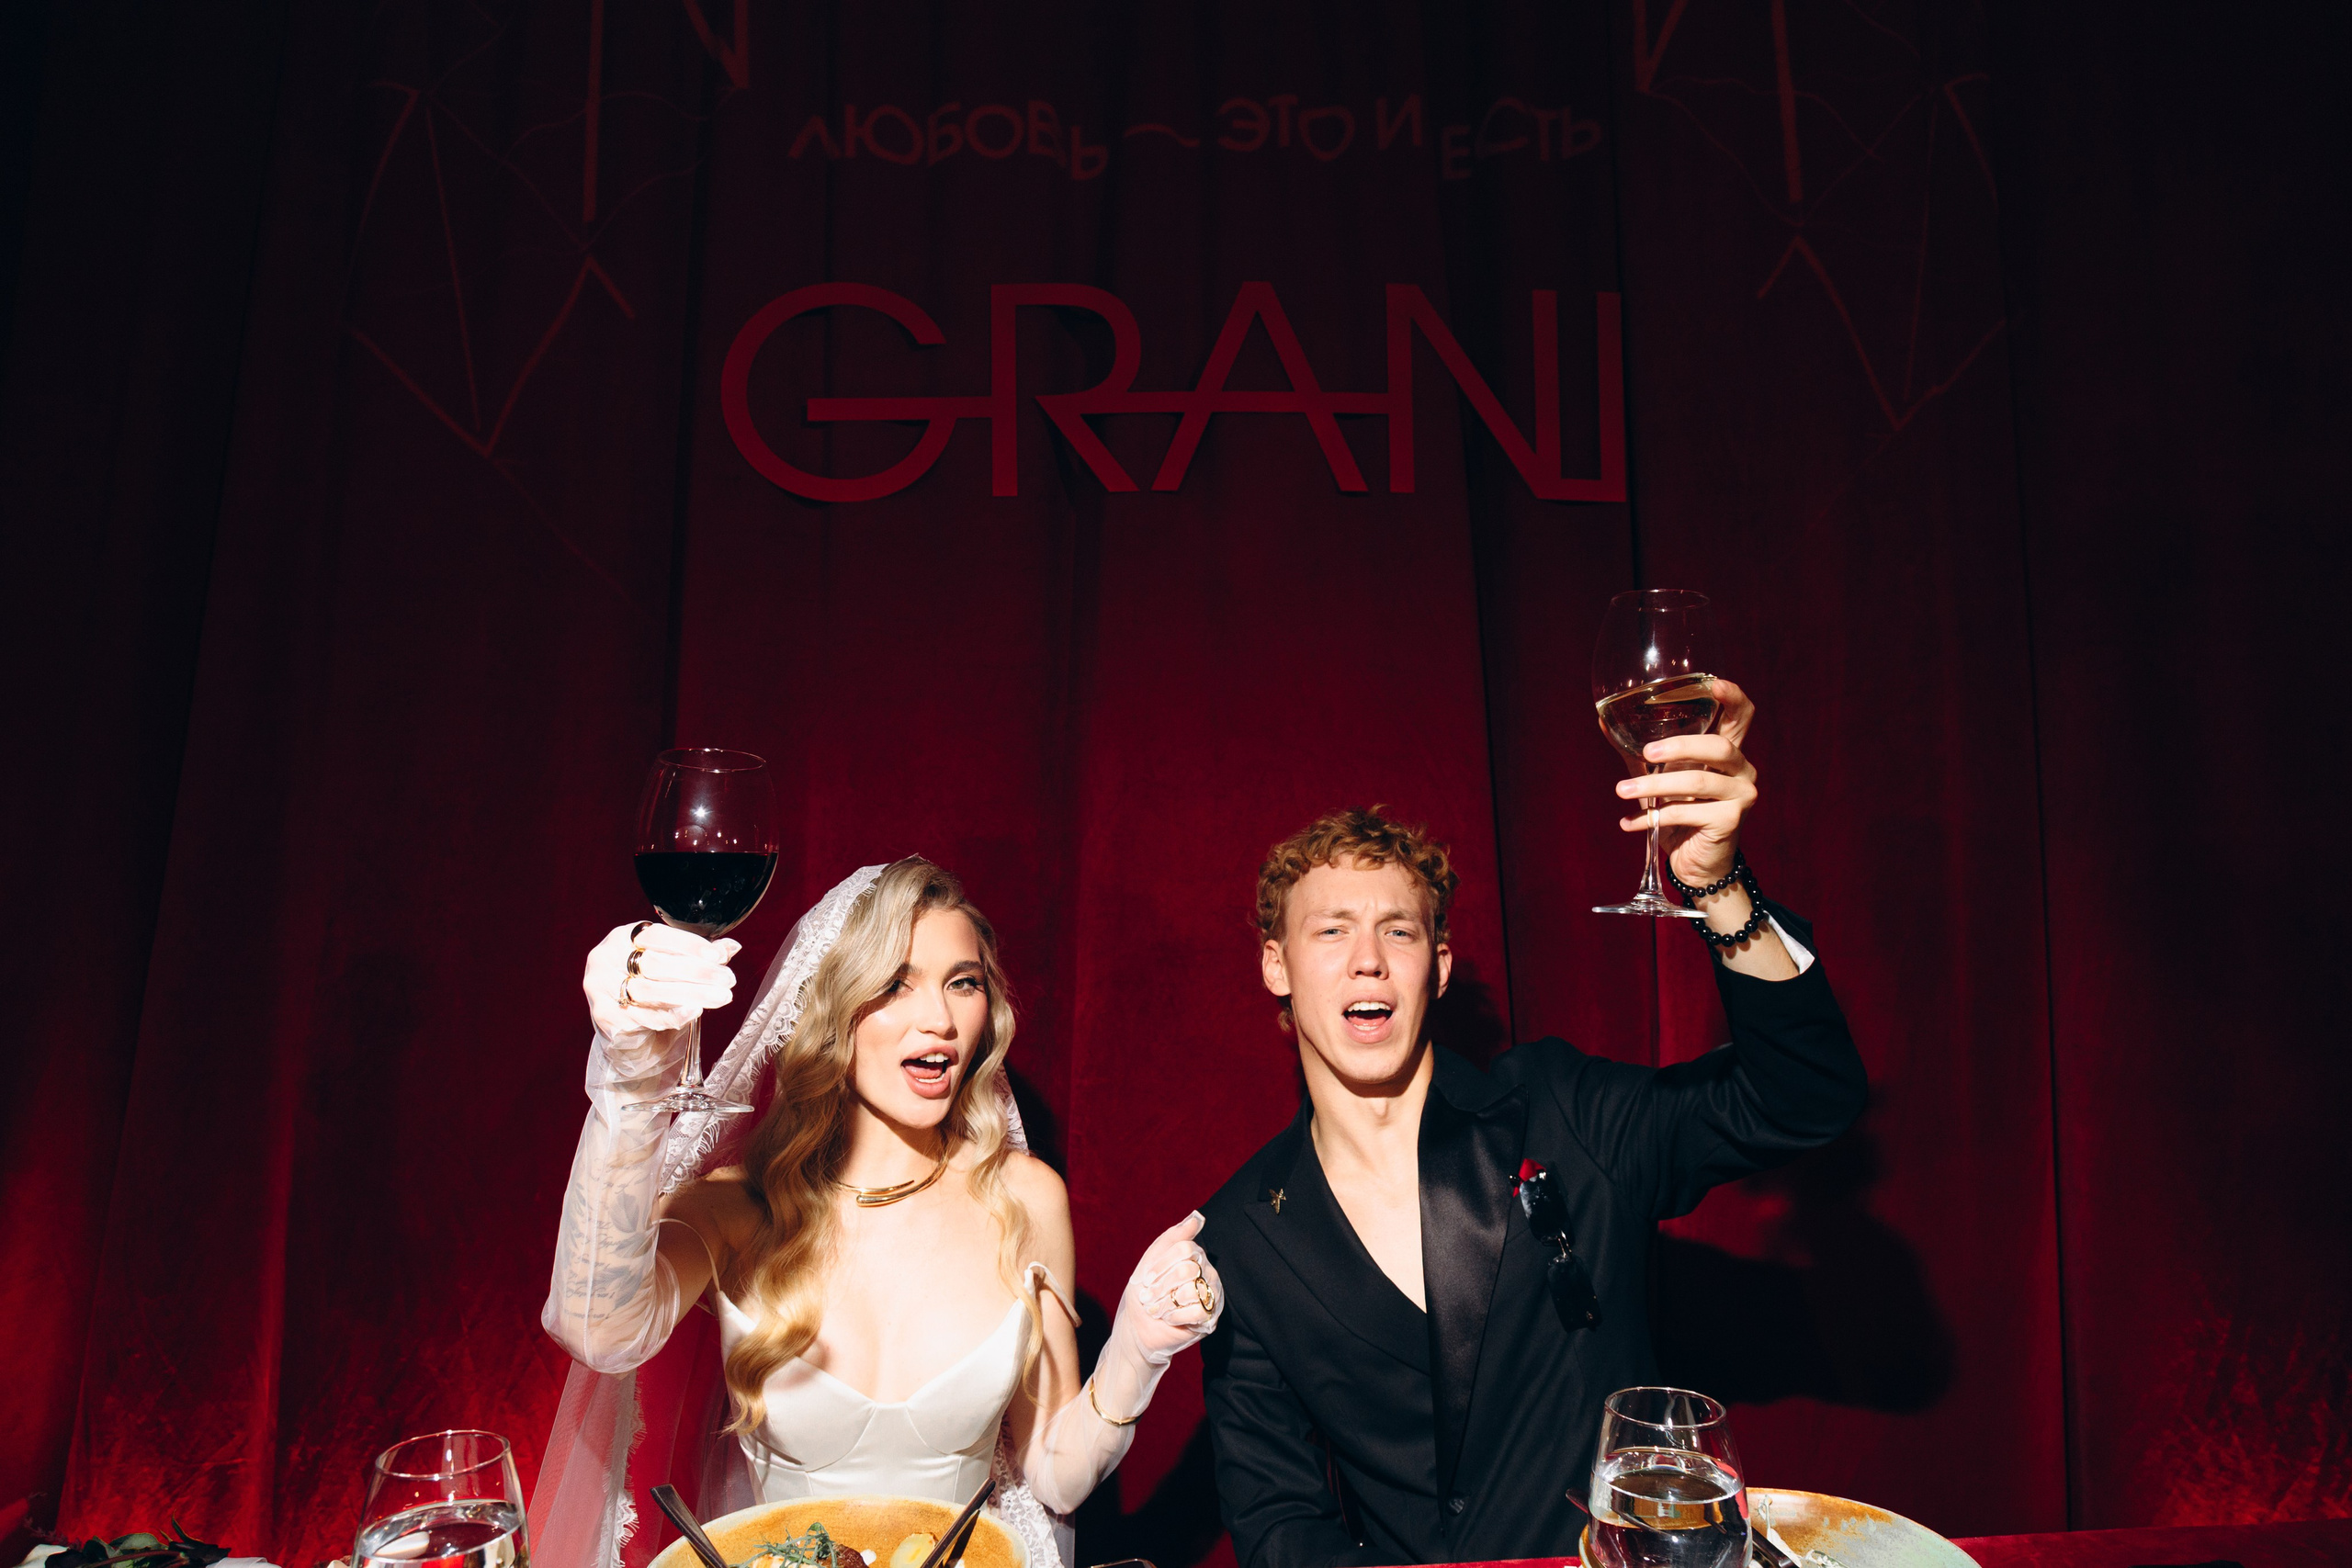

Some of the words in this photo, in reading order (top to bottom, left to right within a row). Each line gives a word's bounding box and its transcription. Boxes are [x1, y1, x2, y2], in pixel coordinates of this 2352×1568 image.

[786, 99, 1109, 181] ЛЮБОВЬ
[1215, 93, 1356, 162] ЭТО
[1374, 92, 1424, 152] И
[1440, 96, 1604, 181] ЕСТЬ
